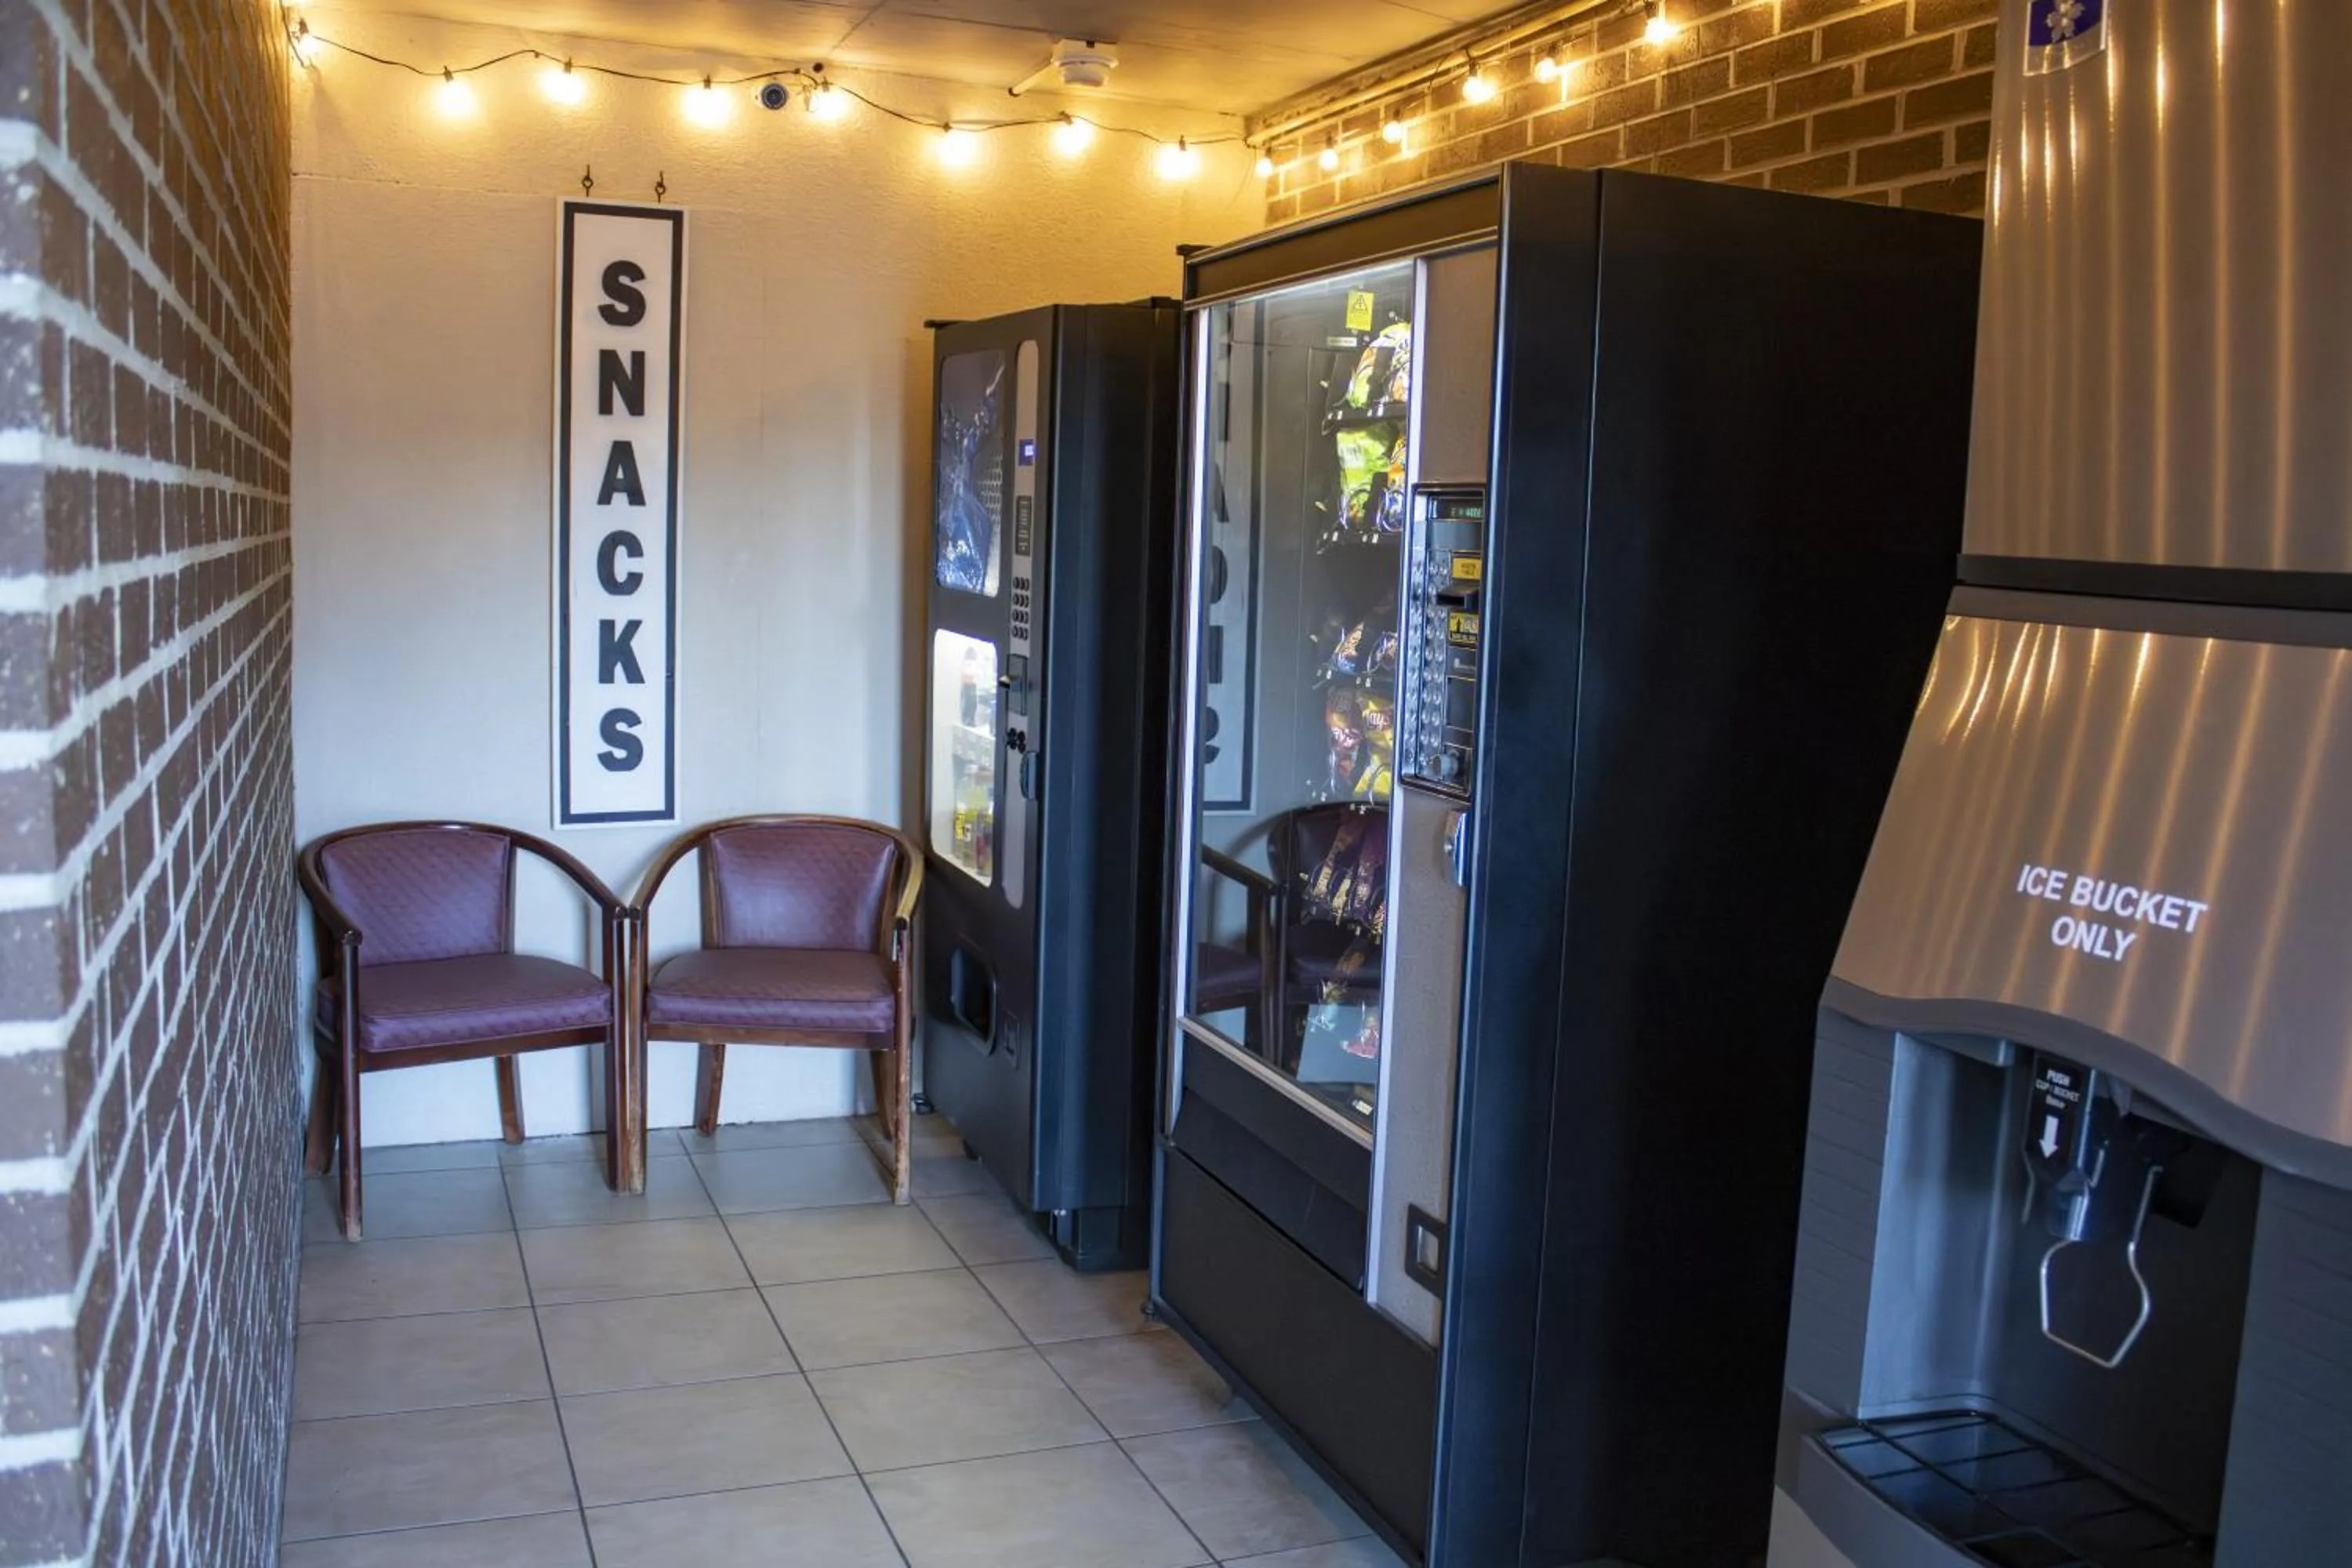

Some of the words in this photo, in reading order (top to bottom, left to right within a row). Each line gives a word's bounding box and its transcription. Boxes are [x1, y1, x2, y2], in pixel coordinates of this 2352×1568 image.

[597, 260, 647, 772] SNACKS
[2016, 864, 2068, 900] ICE
[2070, 875, 2208, 933] BUCKET
[2050, 916, 2136, 961] ONLY
